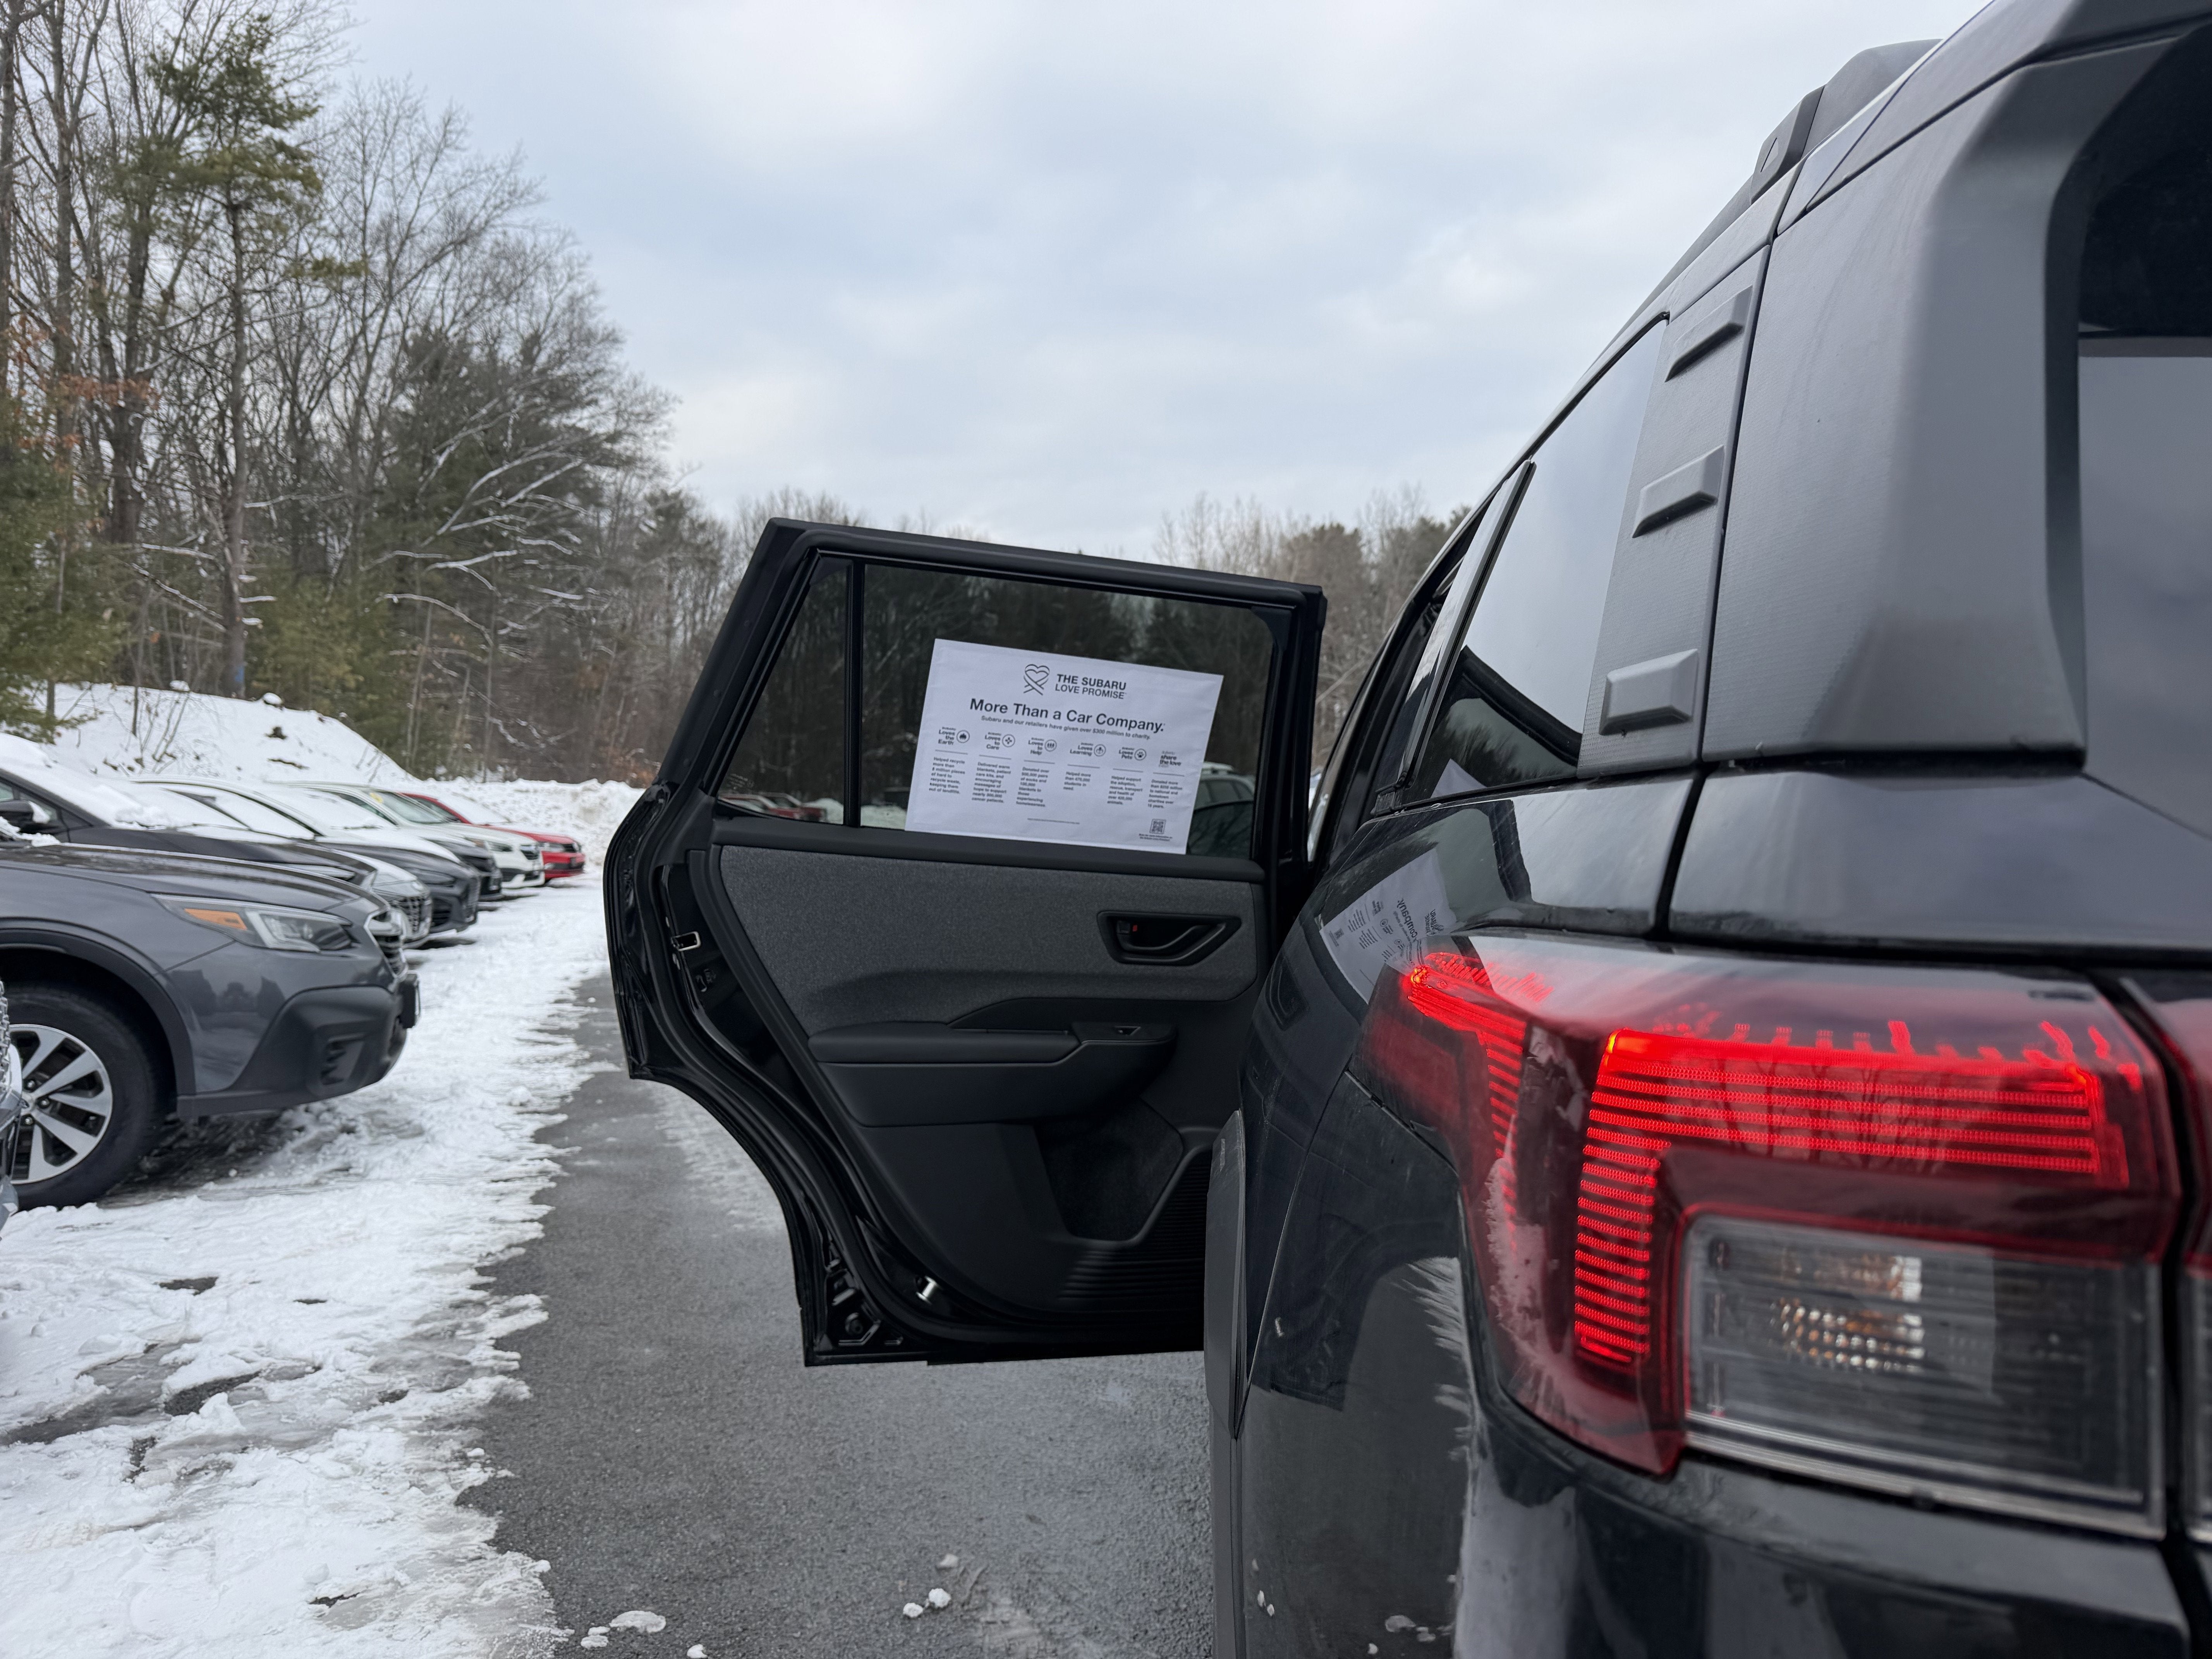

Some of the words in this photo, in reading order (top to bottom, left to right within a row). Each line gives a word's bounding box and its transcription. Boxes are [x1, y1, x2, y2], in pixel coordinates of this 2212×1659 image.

[1057, 674, 1078, 684] THE
[1081, 677, 1126, 690] SUBARU
[1055, 684, 1080, 694] LOVE
[1082, 687, 1125, 699] PROMISE
[970, 698, 1008, 713] More
[1013, 703, 1048, 718] Than
[1053, 711, 1061, 720] a
[1066, 710, 1092, 723] Car
[1096, 713, 1163, 733] Company.
